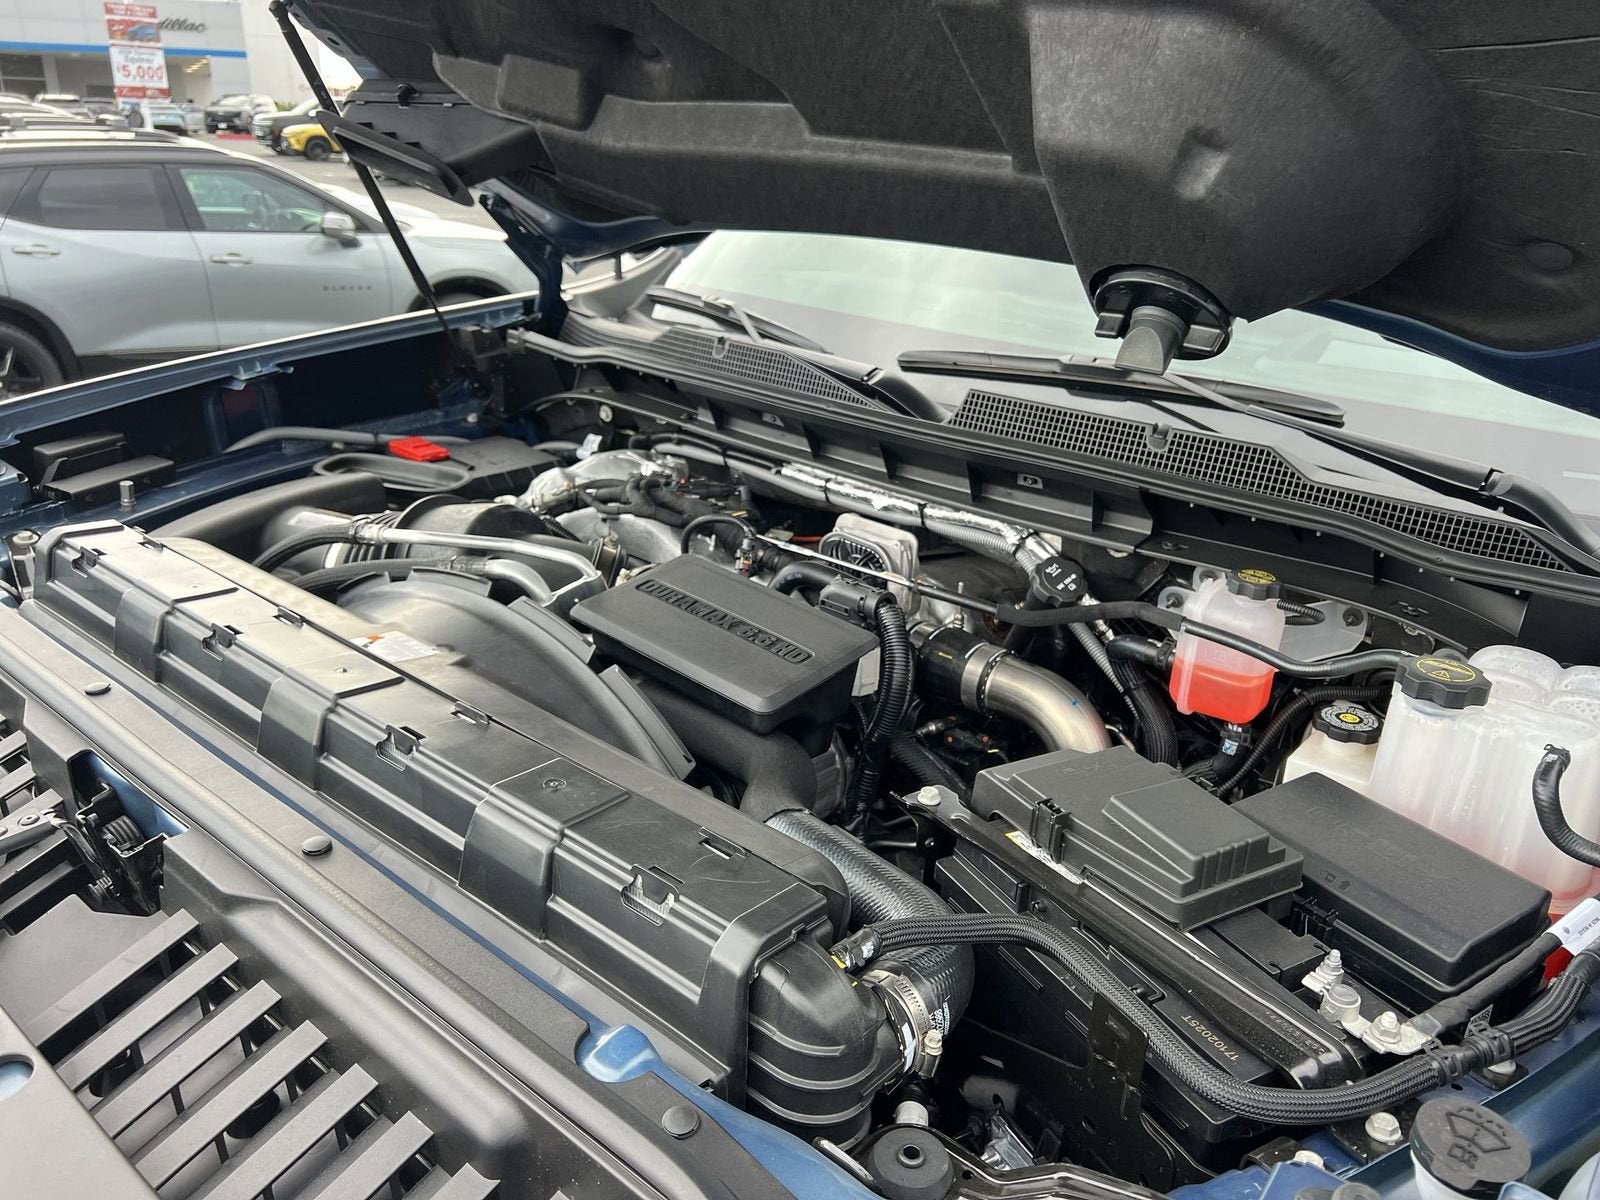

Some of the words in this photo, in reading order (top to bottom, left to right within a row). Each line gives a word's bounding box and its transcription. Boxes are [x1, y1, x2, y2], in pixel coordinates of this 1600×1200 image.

[158, 17, 207, 33] dillac
[643, 579, 738, 631] DURAMAX
[775, 639, 811, 662] HD
